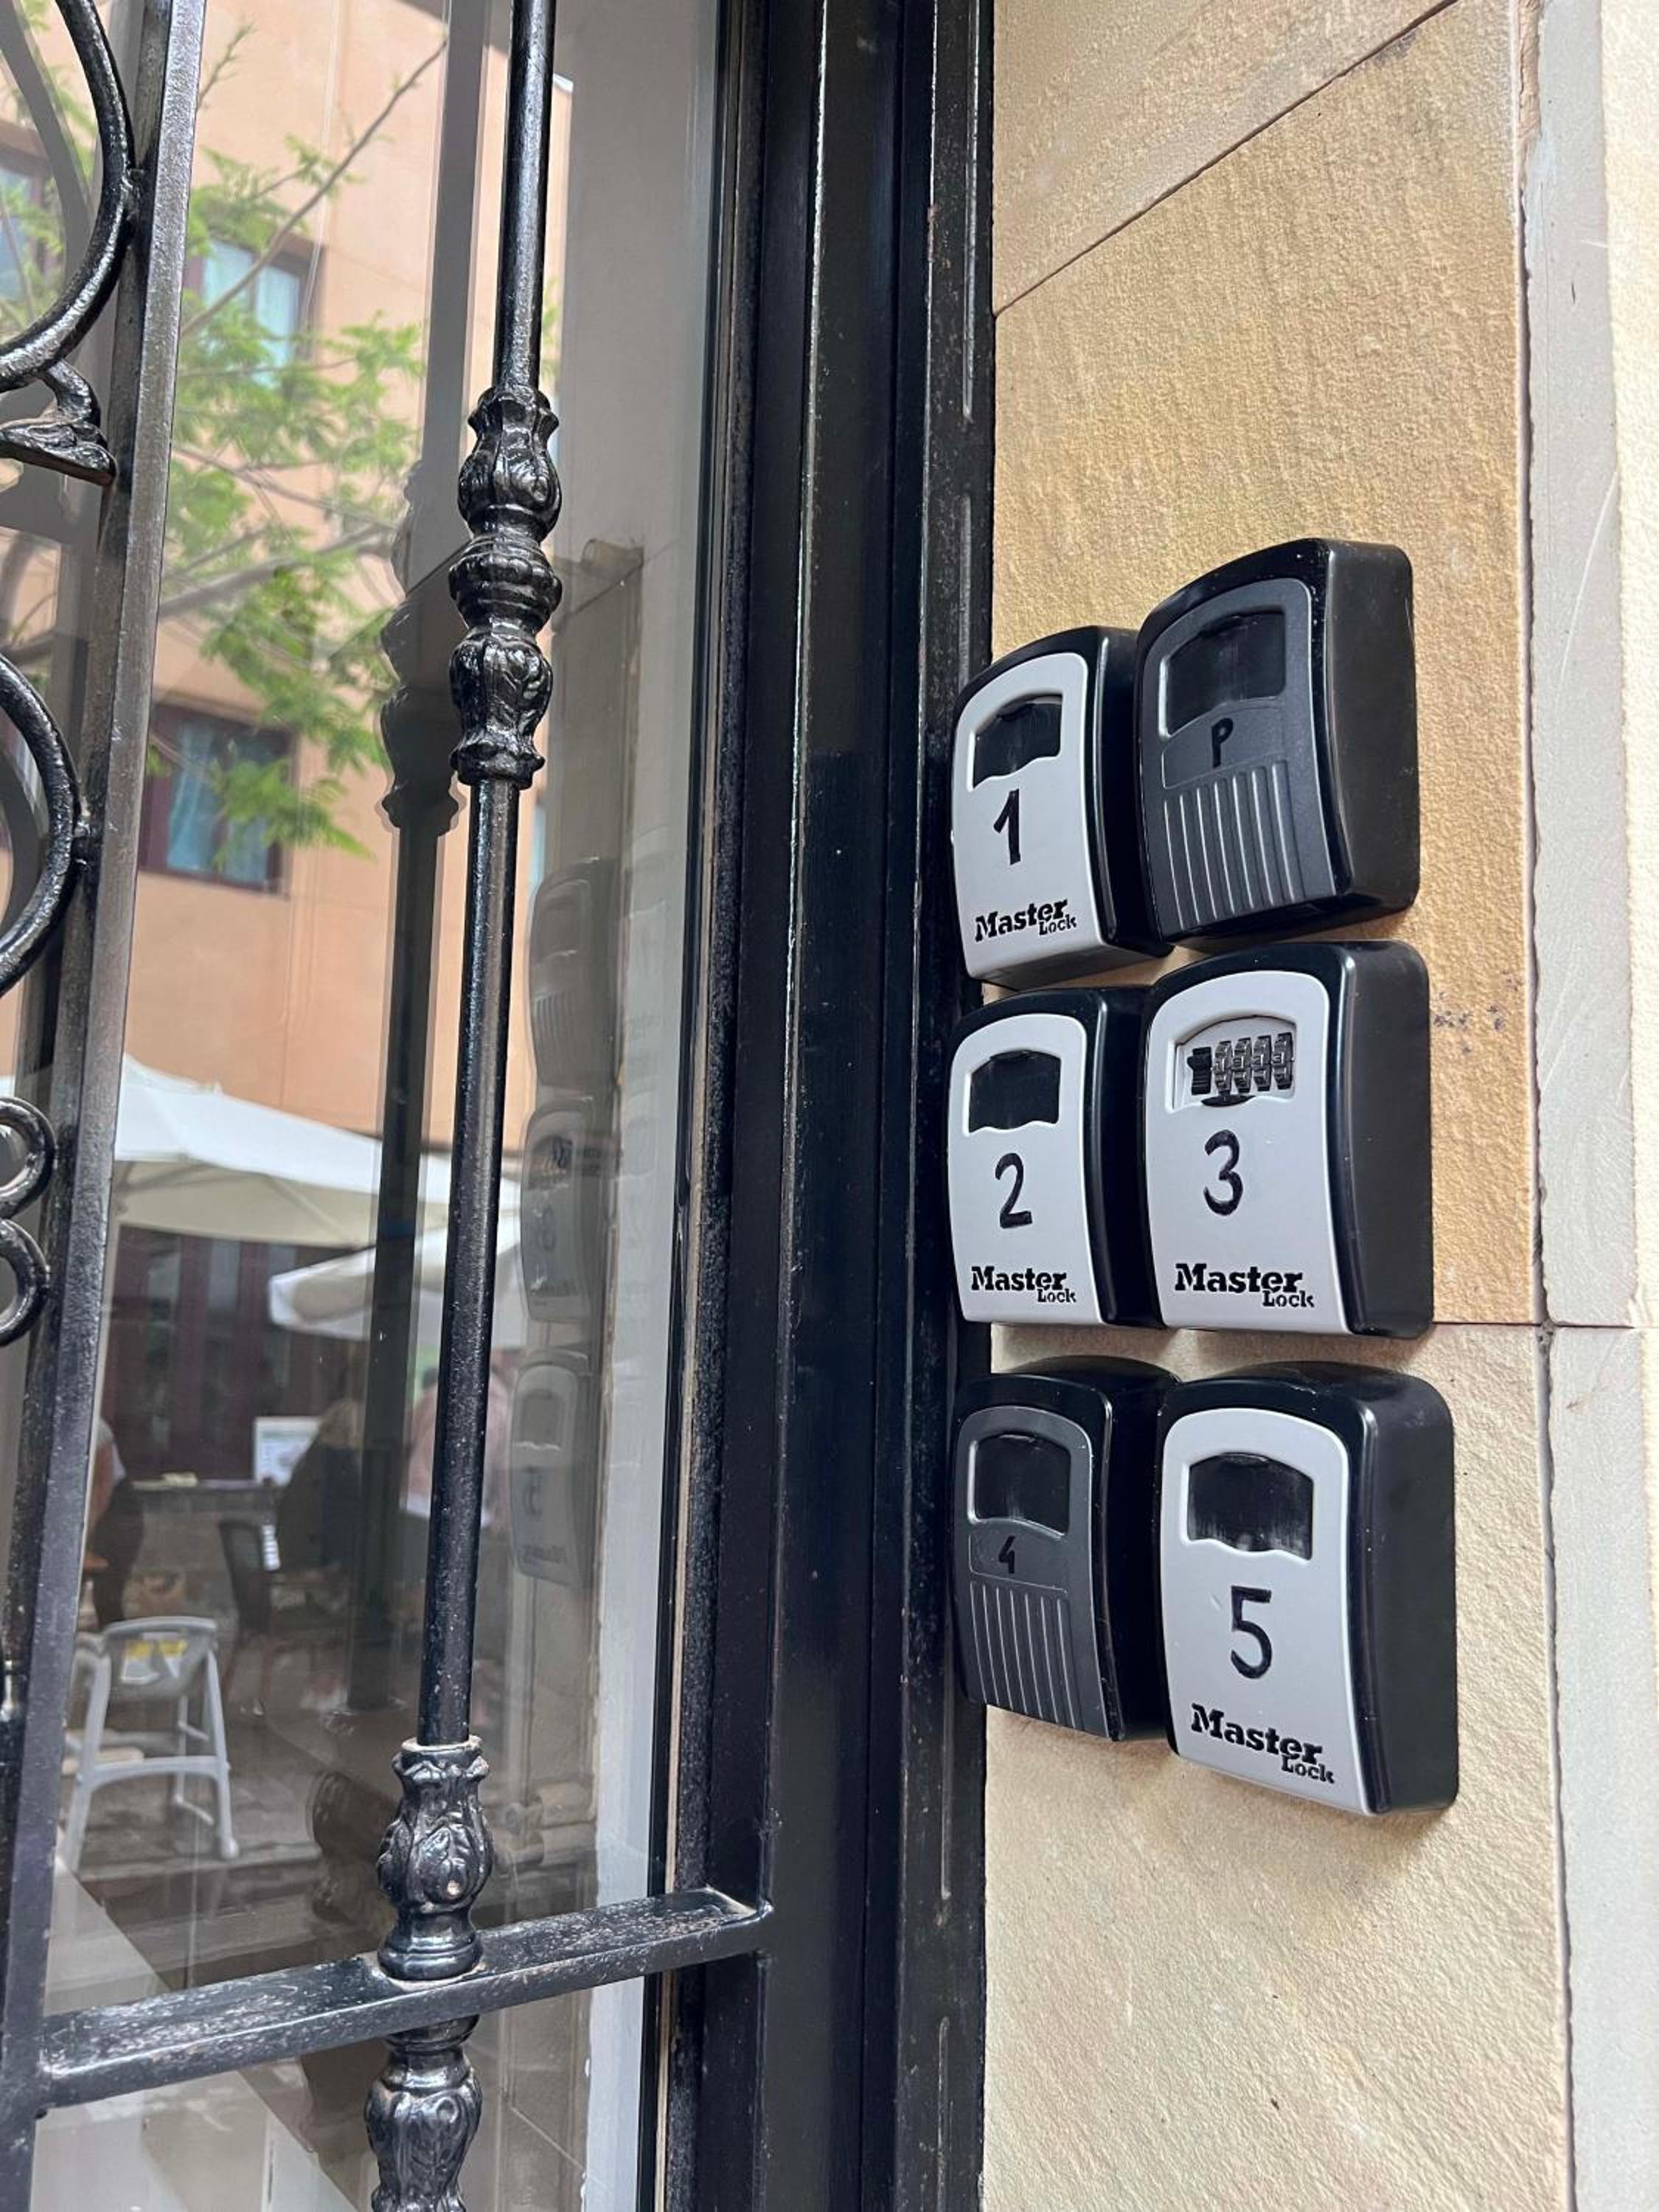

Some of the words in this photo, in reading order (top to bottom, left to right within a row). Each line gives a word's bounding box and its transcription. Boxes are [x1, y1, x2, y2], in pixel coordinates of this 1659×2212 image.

[1211, 717, 1234, 769] P
[993, 788, 1021, 866] 1
[975, 899, 1068, 942] Master
[1039, 914, 1077, 936] Lock
[995, 1152, 1033, 1229] 2
[1203, 1129, 1243, 1216] 3
[971, 1265, 1067, 1291] Master
[1037, 1288, 1077, 1303] Lock
[1175, 1263, 1303, 1294] Master
[1262, 1290, 1315, 1307] Lock
[997, 1535, 1015, 1574] 4
[1231, 1585, 1273, 1679] 5
[1191, 1703, 1323, 1765] Master
[1281, 1755, 1335, 1784] Lock
